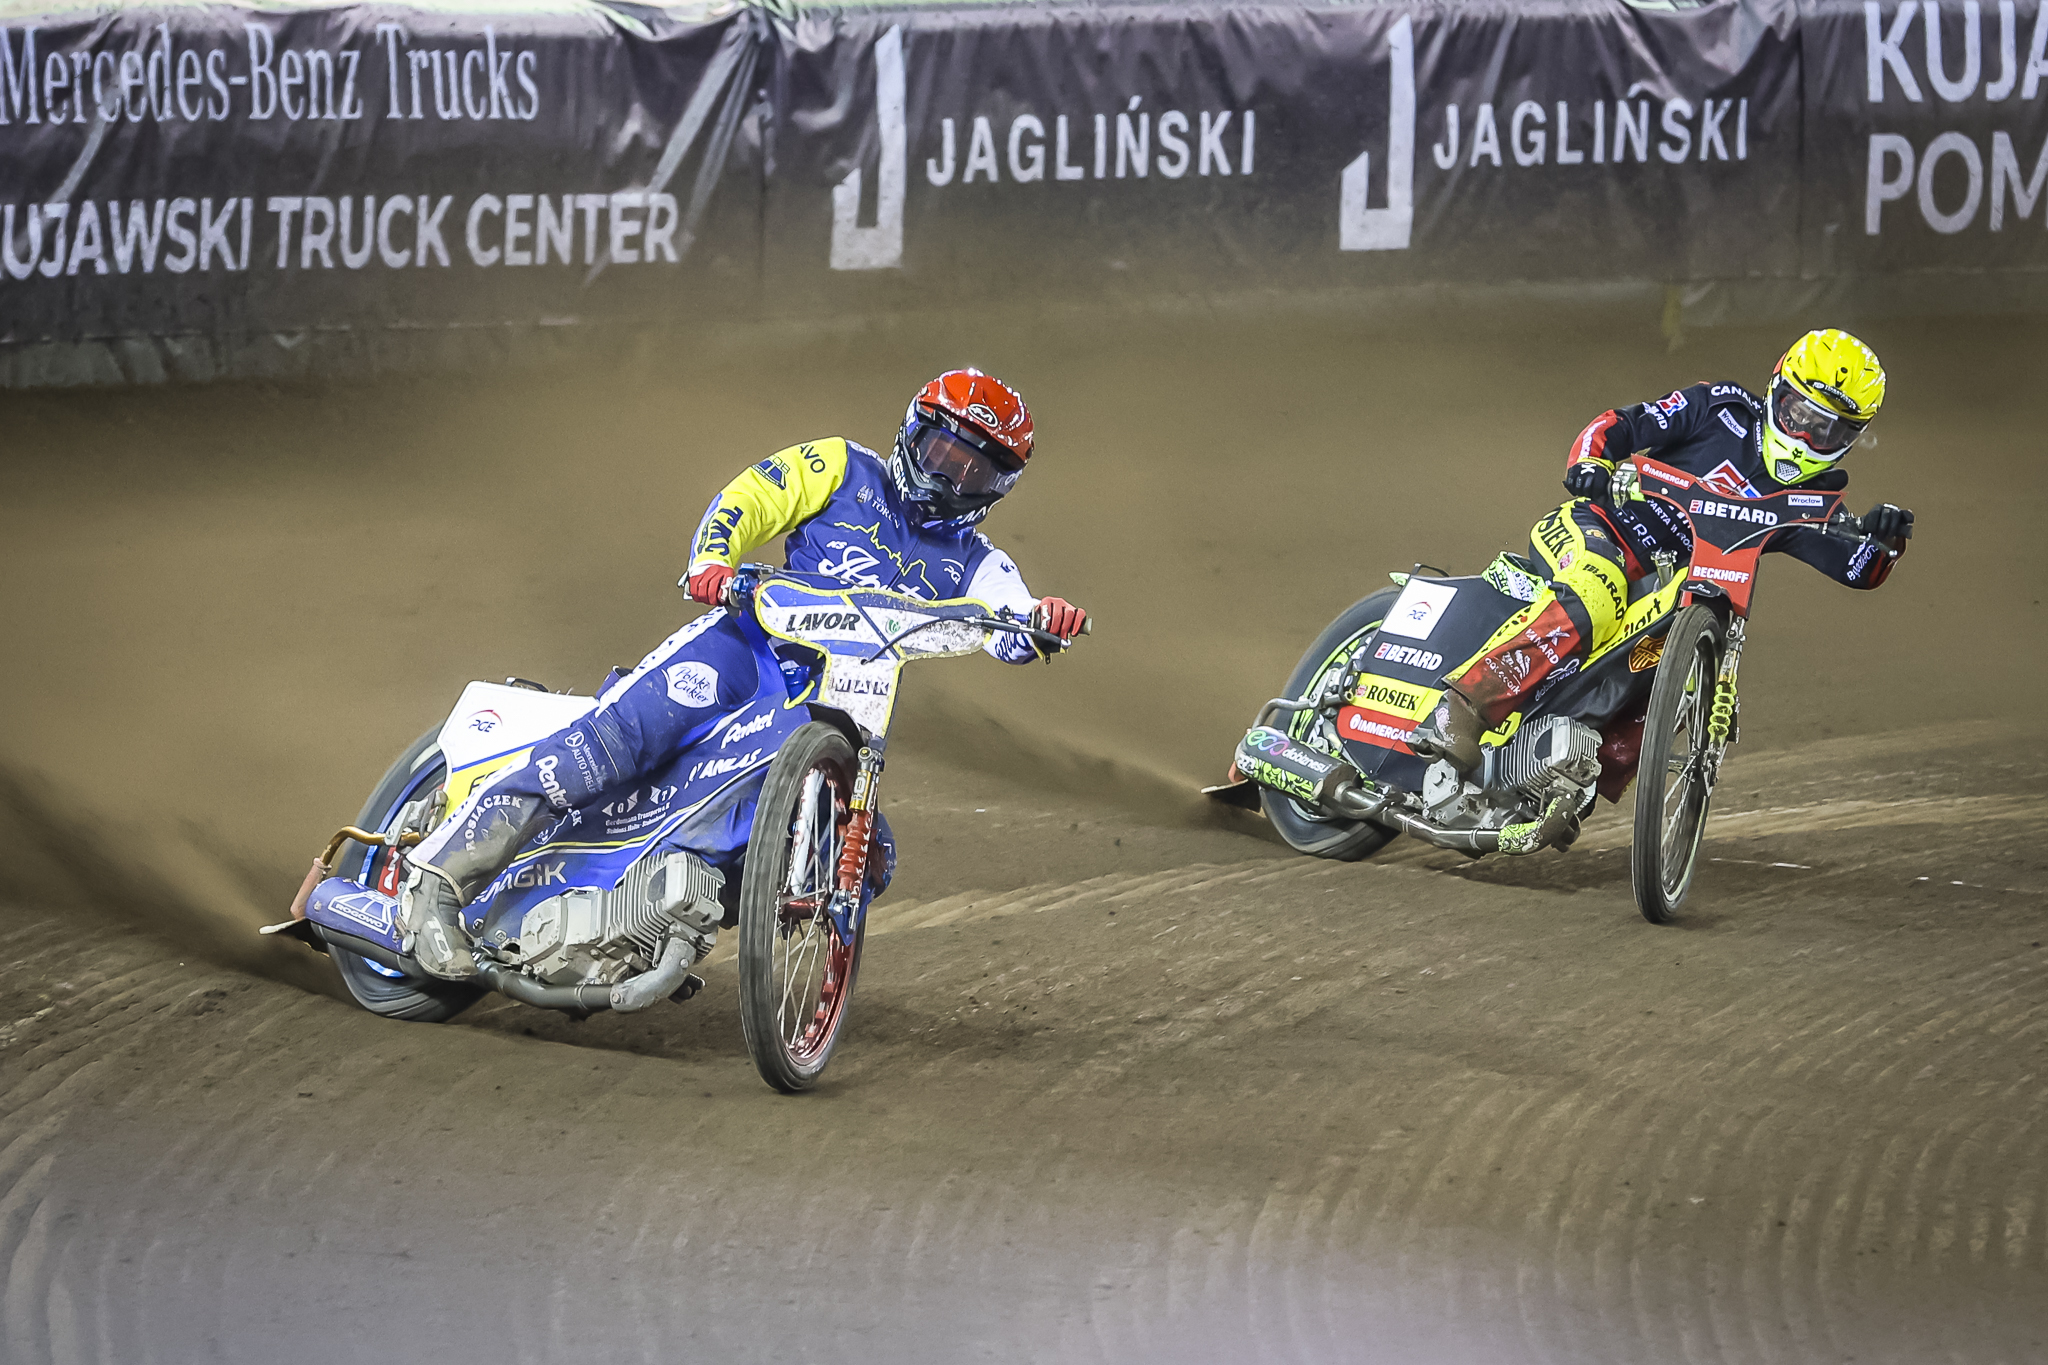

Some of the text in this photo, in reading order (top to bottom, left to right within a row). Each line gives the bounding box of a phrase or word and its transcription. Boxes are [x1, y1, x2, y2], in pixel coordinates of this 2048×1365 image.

[0, 22, 539, 126] Mercedes-Benz Trucks
[926, 94, 1257, 187] JAGLIŃSKI
[1865, 130, 2048, 236] POM
[0, 192, 681, 280] UJAWSKI TRUCK CENTER
[1703, 500, 1779, 526] BETARD
[1692, 565, 1750, 584] BECKHOFF
[786, 612, 861, 633] LAVOR
[1385, 643, 1443, 672] BETARD
[674, 666, 711, 691] Polski
[673, 680, 709, 704] Cukier
[1366, 684, 1420, 711] ROSIEK
[469, 719, 496, 733] PGE
[335, 903, 385, 929] ROGOWO
